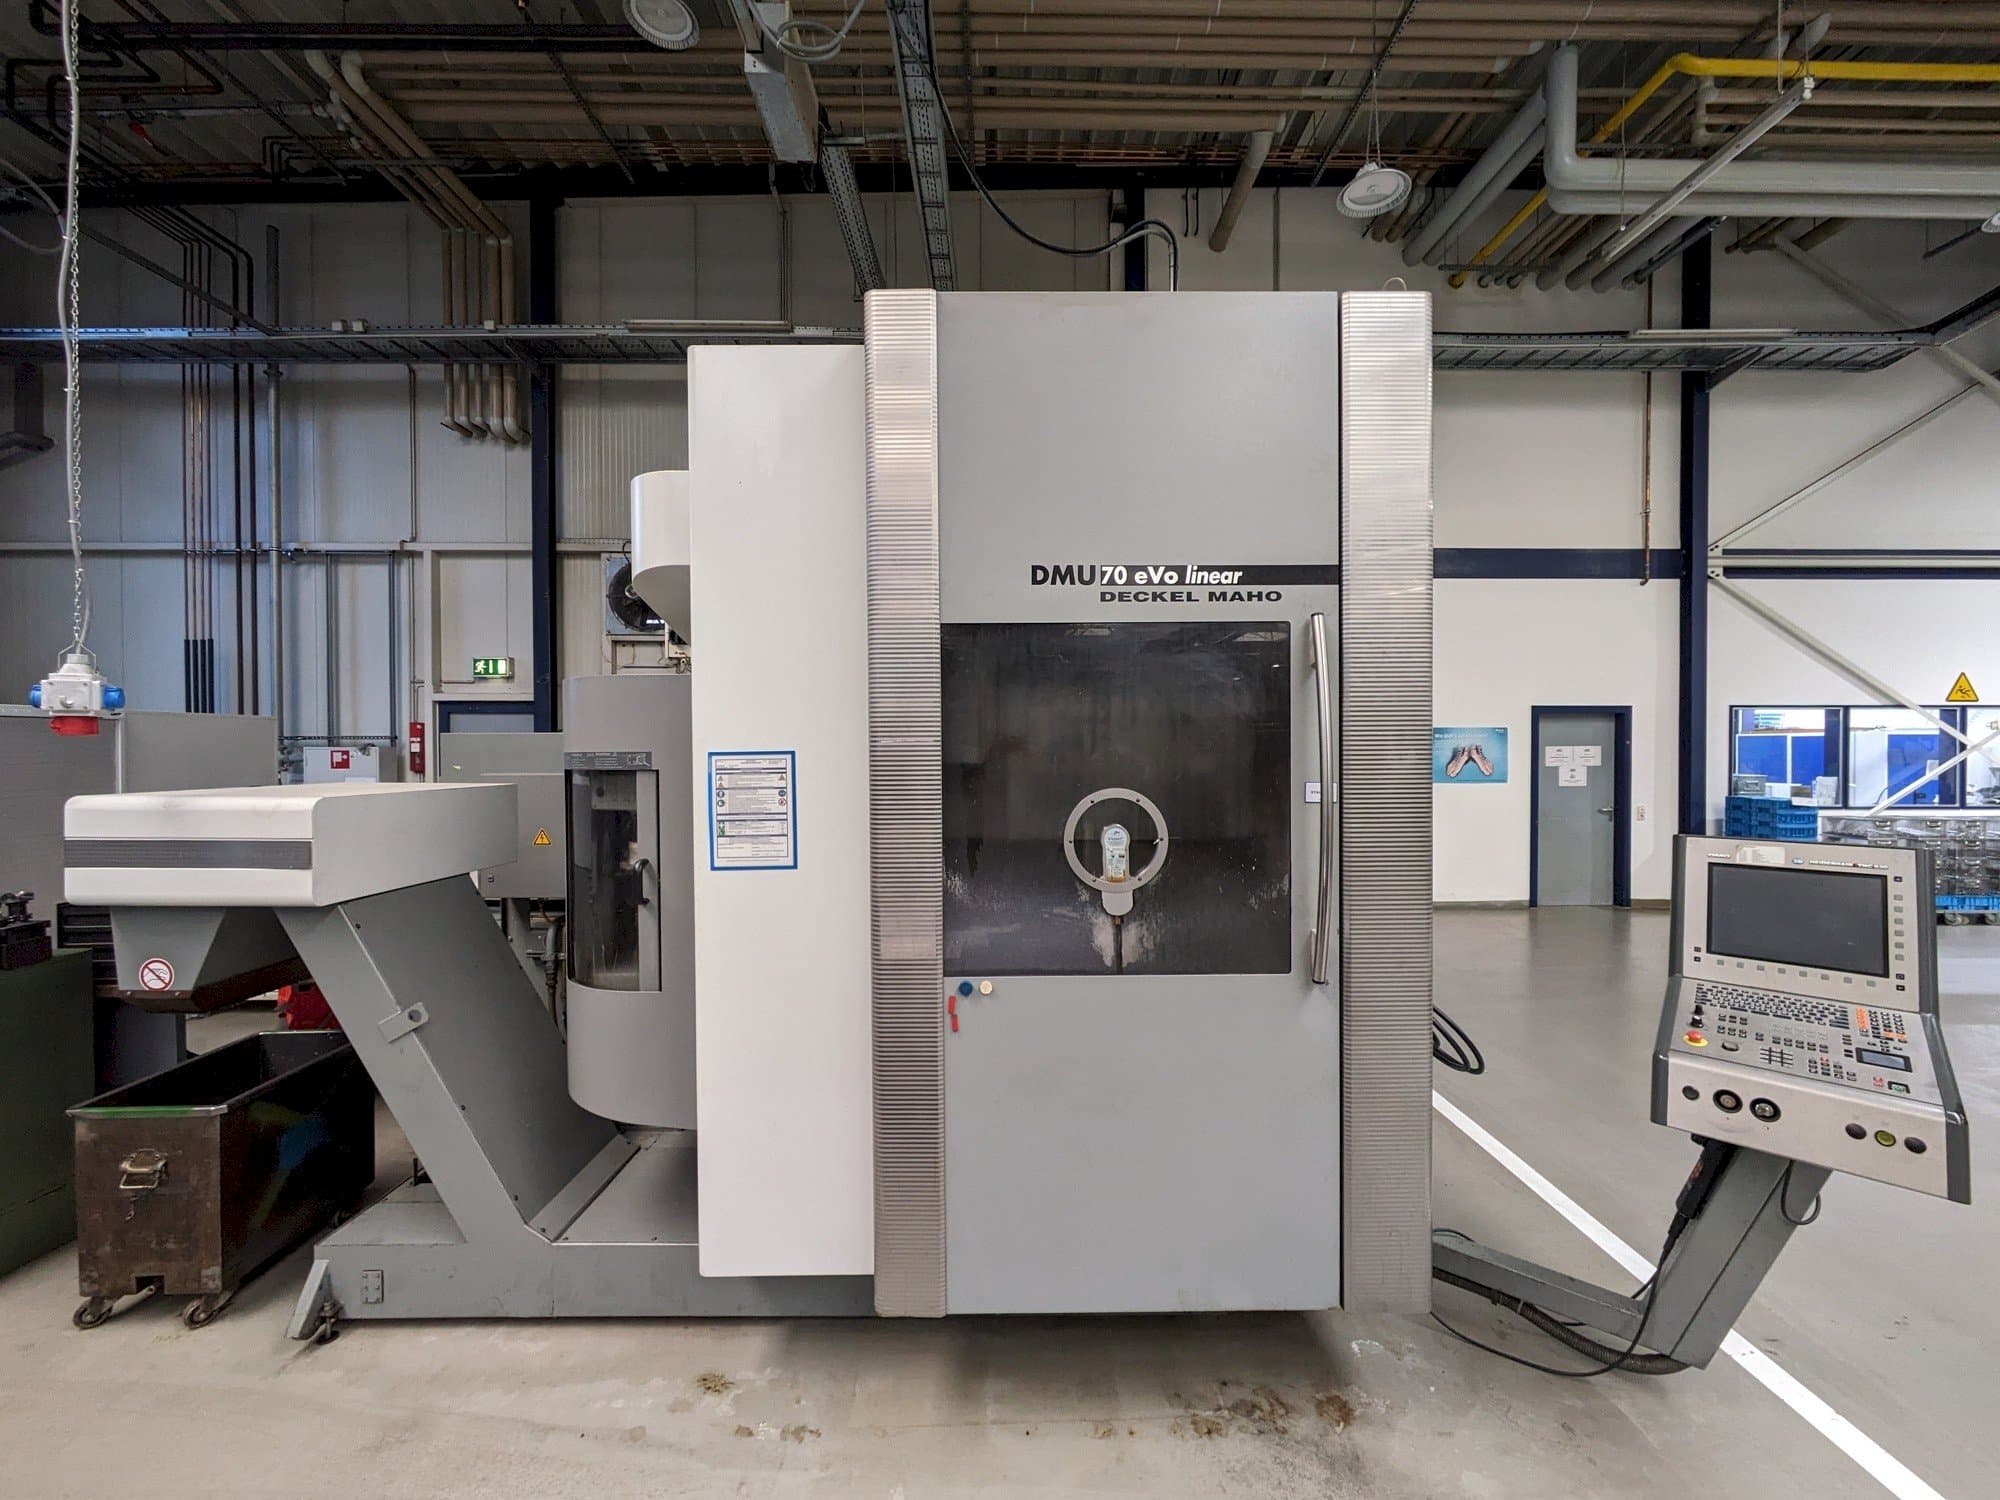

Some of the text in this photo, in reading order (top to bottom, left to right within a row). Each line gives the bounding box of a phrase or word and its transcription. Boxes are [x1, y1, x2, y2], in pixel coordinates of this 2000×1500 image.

[1031, 565, 1243, 586] DMU 70 eVo linear
[1100, 591, 1283, 602] DECKEL MAHO
